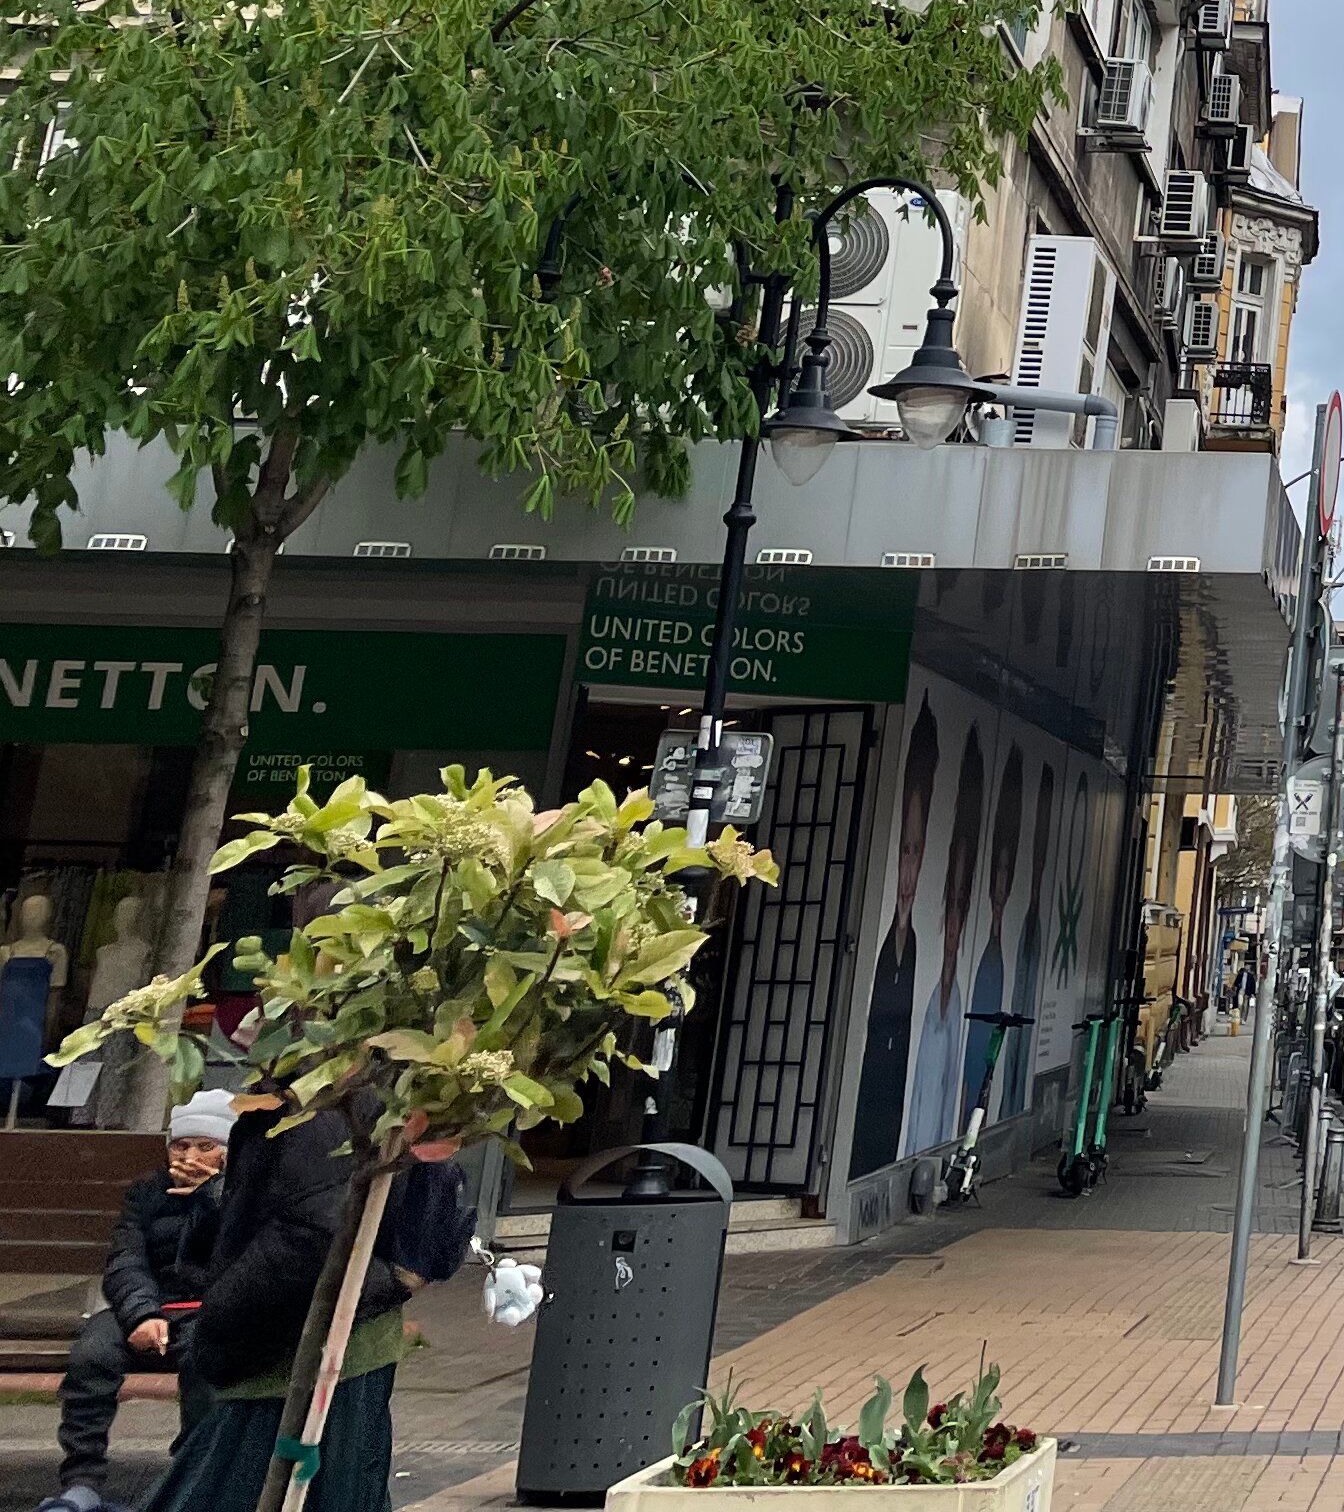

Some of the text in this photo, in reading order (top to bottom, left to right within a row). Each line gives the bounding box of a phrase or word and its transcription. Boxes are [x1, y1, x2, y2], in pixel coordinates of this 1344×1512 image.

[590, 614, 805, 654] UNITED CLORS
[584, 646, 778, 683] OF BENETON.
[249, 754, 303, 767] UNITED
[247, 769, 268, 782] OF
